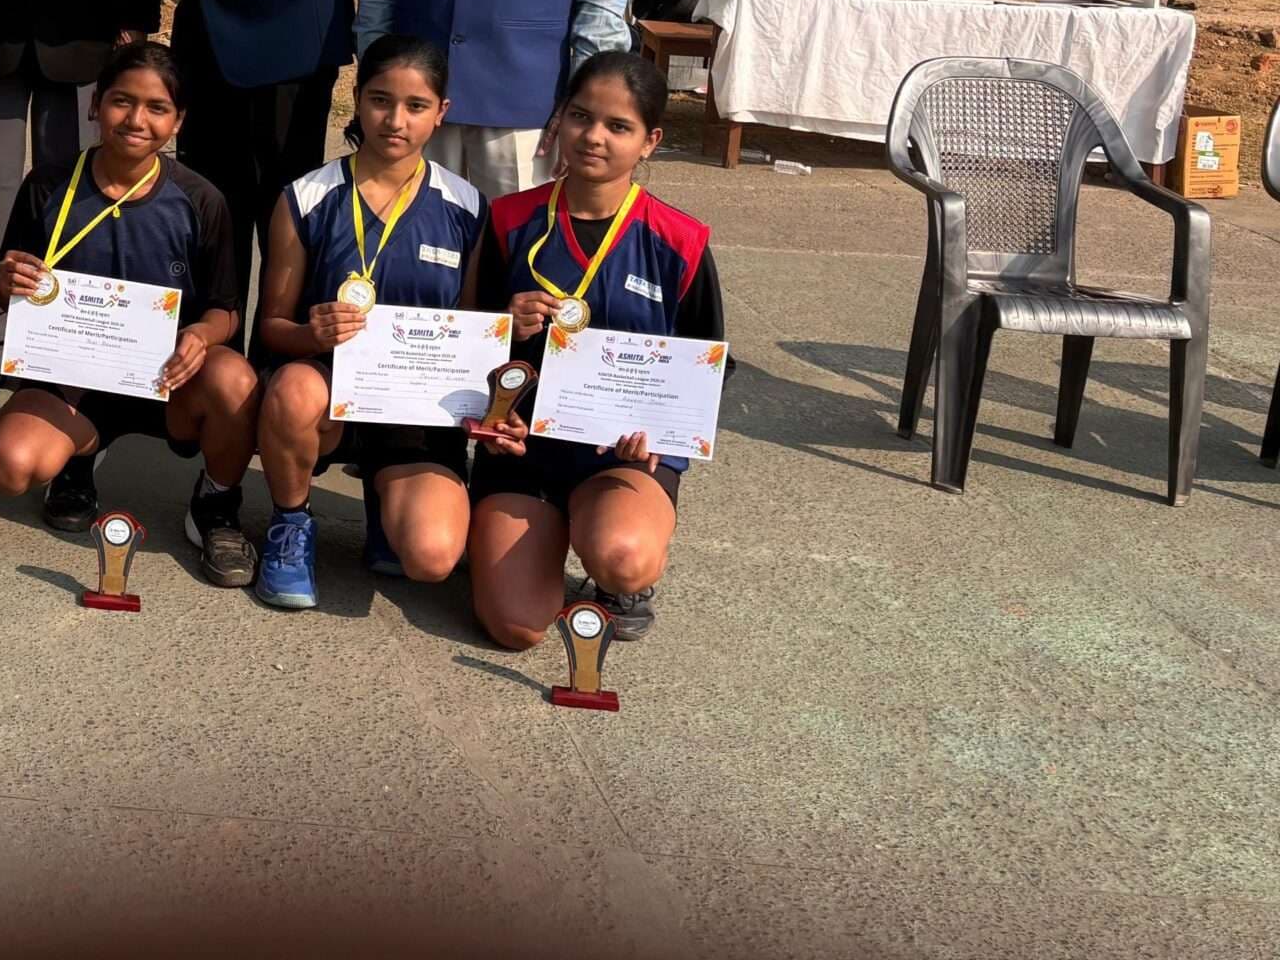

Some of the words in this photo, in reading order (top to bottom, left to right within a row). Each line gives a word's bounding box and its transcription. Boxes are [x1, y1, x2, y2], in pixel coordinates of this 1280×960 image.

[79, 295, 104, 305] ASMITA
[408, 328, 434, 337] ASMITA
[617, 352, 645, 362] ASMITA
